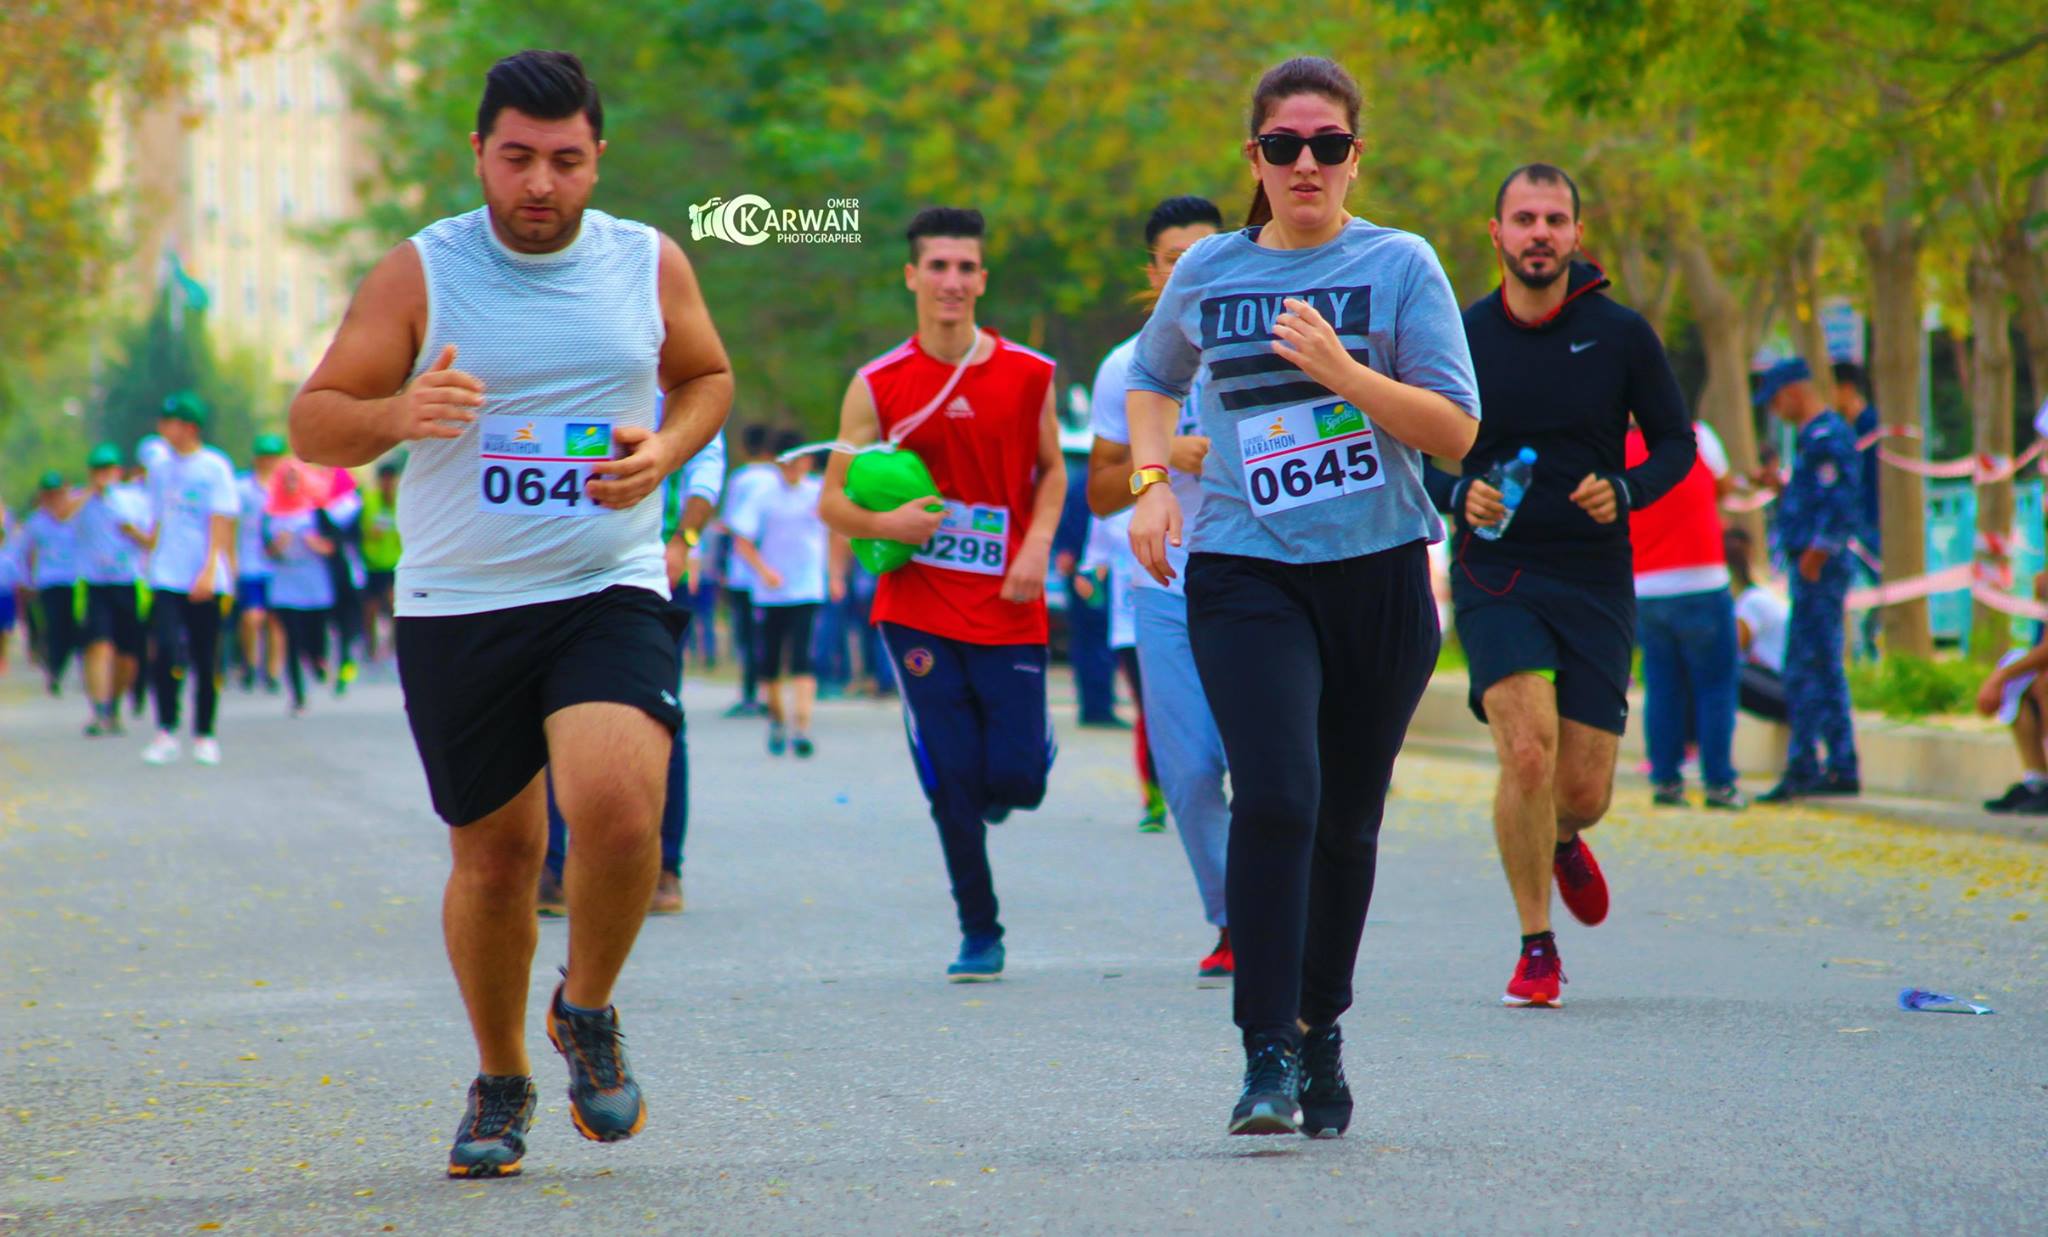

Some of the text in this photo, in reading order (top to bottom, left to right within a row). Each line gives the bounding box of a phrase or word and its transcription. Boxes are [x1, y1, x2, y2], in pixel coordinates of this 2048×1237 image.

[1216, 292, 1352, 339] LOVY
[1244, 433, 1297, 457] MARATHON
[1250, 440, 1379, 506] 0645
